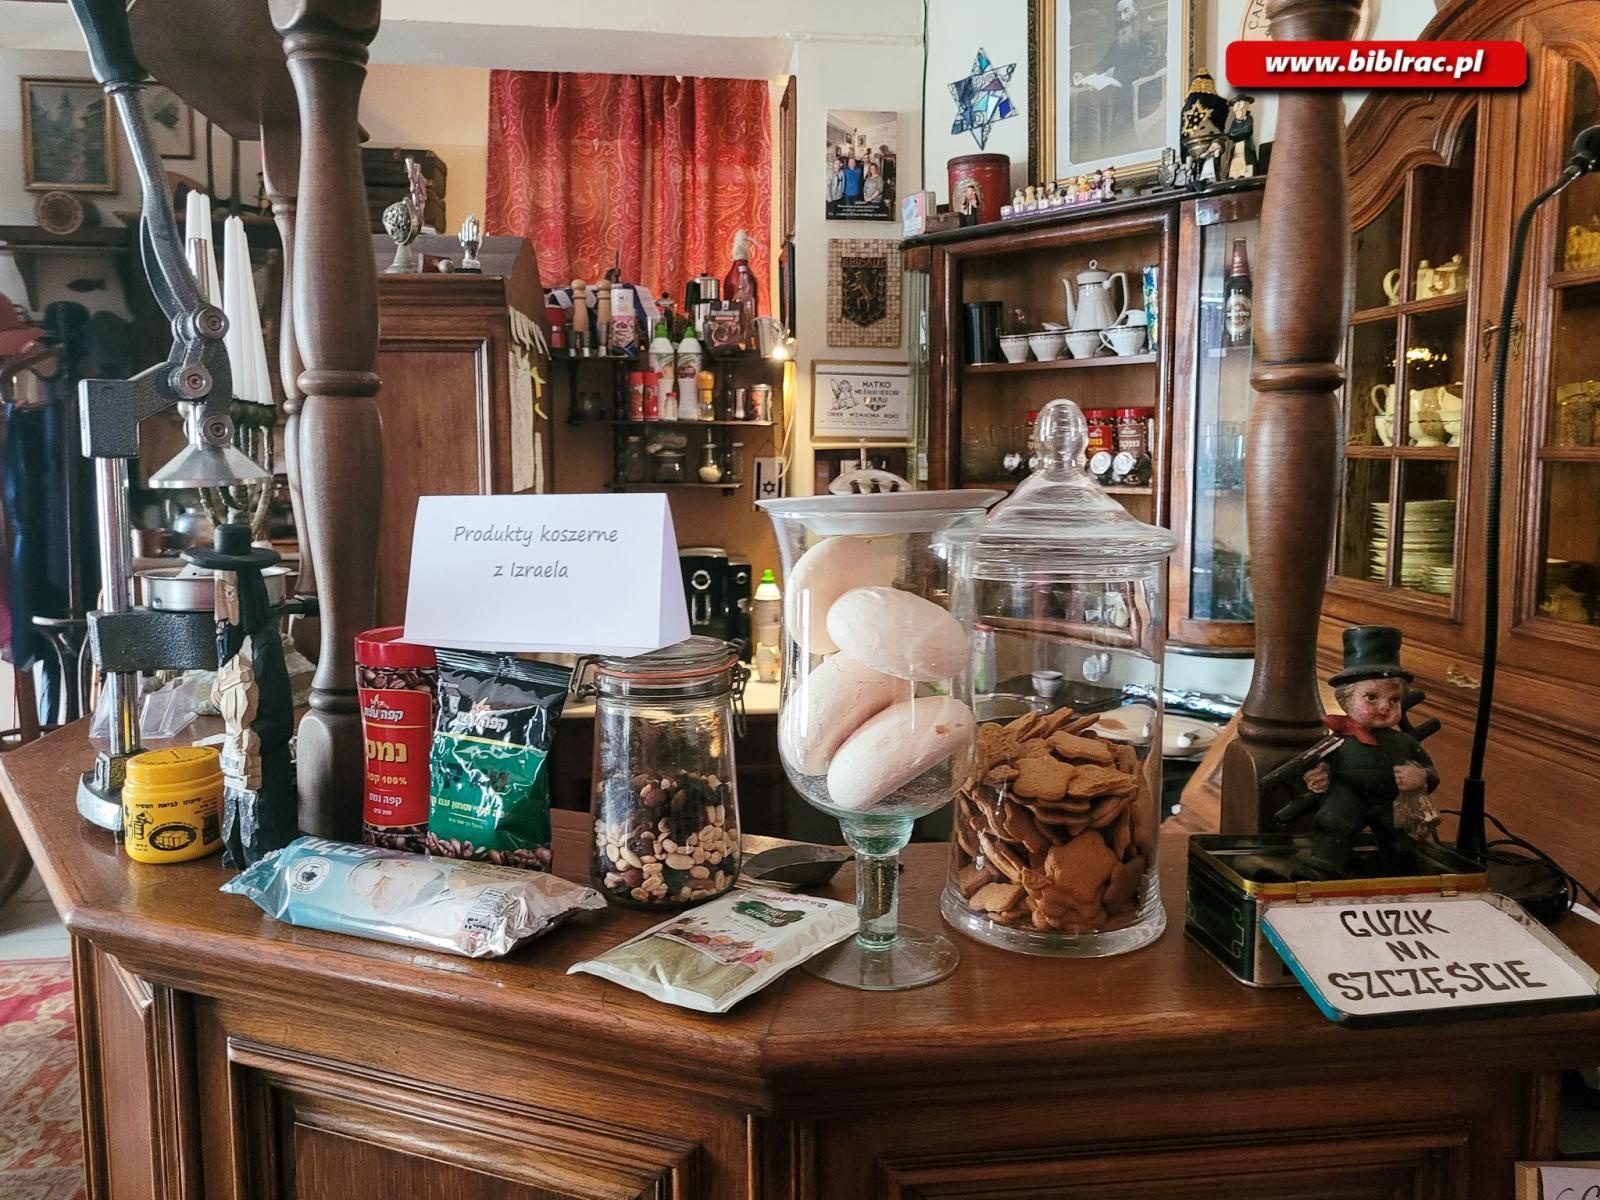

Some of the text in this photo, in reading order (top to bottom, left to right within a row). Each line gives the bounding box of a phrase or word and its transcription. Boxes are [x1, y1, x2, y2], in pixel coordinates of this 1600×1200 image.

[862, 381, 891, 389] MATKO
[453, 524, 619, 547] Produkty koszerne
[492, 560, 569, 579] z Izraela
[380, 709, 404, 723] קפה
[367, 739, 408, 763] נמס
[367, 771, 408, 785] 100% קפ
[382, 795, 402, 807] קפה
[1339, 908, 1450, 938] GUZIK
[1385, 940, 1440, 962] NA
[1327, 960, 1548, 1001] SZCZĘŚCIE
